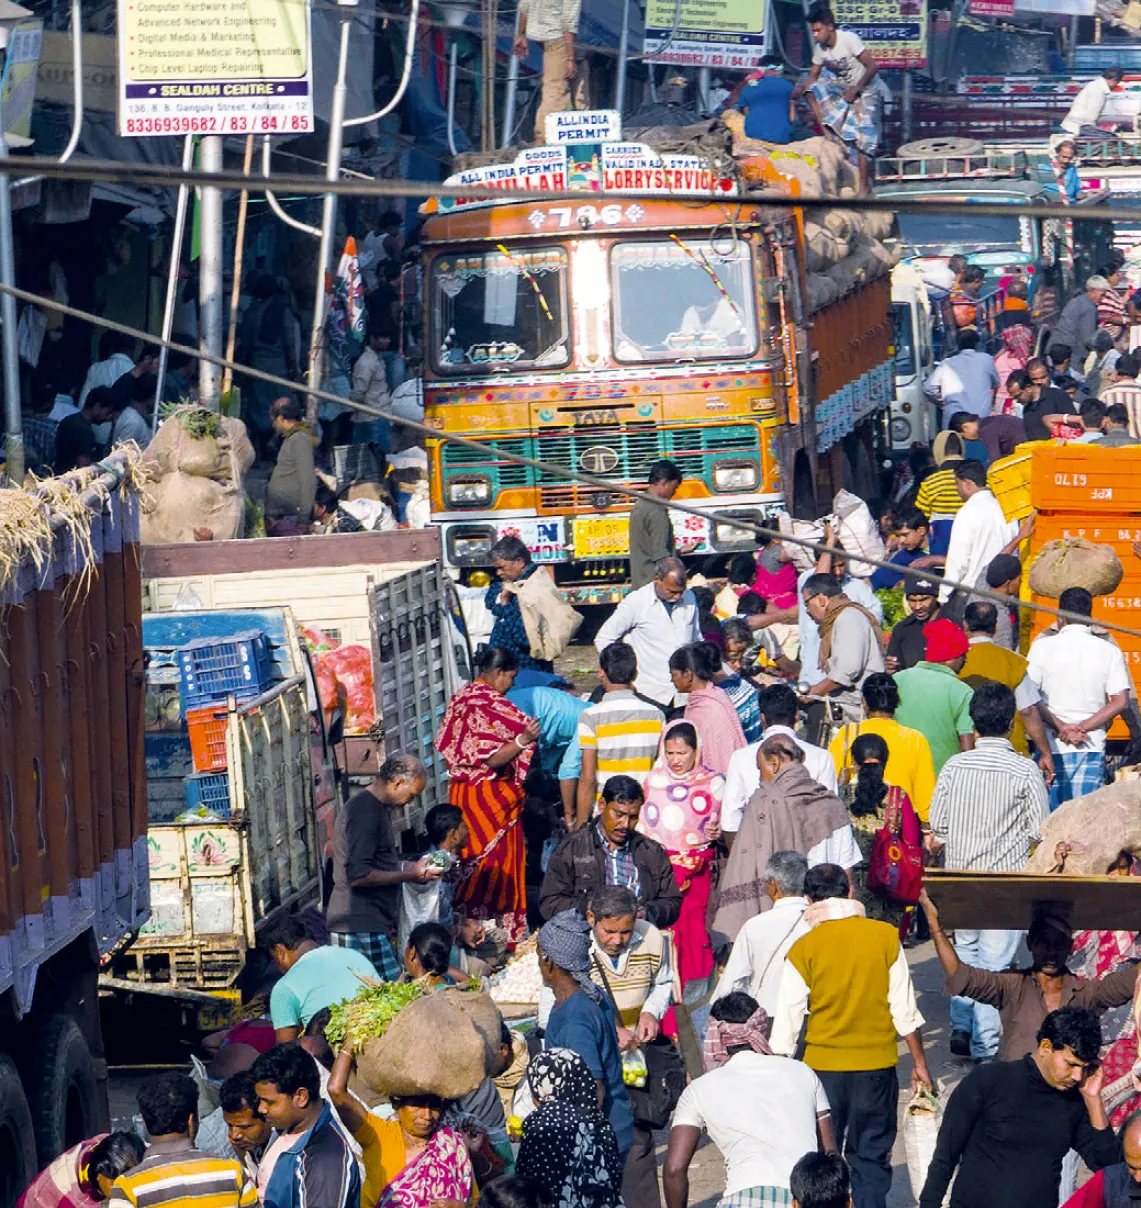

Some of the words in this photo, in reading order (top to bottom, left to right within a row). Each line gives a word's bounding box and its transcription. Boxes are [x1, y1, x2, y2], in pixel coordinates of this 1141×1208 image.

[138, 2, 183, 13] Computer
[184, 2, 229, 11] Hardware
[231, 2, 247, 10] and
[836, 6, 864, 14] SSC
[138, 17, 181, 27] Advanced
[184, 17, 220, 26] Network
[224, 16, 278, 28] Engineering
[869, 14, 925, 23] Selection
[138, 34, 168, 44] Digital
[170, 33, 197, 42] Media
[211, 32, 257, 44] Marketing
[138, 49, 195, 58] Professional
[197, 48, 232, 57] Medical
[235, 47, 302, 58] Representative
[138, 64, 159, 74] Chip
[161, 64, 186, 73] Level
[188, 63, 217, 74] Laptop
[221, 62, 264, 74] Repairing
[161, 85, 220, 97] SEALDAH
[223, 84, 275, 96] CENTRE
[176, 103, 214, 114] Ganguly
[251, 101, 286, 111] Kolkata
[297, 101, 307, 111] 12
[126, 117, 217, 133] 8336939682
[230, 116, 248, 131] 83
[261, 116, 278, 131] 84
[291, 115, 310, 130] 85
[558, 128, 610, 141] PERMIT
[525, 150, 562, 160] GOODS
[460, 172, 482, 185] ALL
[485, 167, 517, 180] INDIA
[519, 163, 564, 176] PERMIT
[605, 159, 635, 169] VALID
[637, 160, 647, 168] IN
[548, 203, 623, 228] 786
[572, 410, 620, 425] TATA
[1054, 472, 1087, 487] 6170
[1090, 488, 1113, 500] KPF
